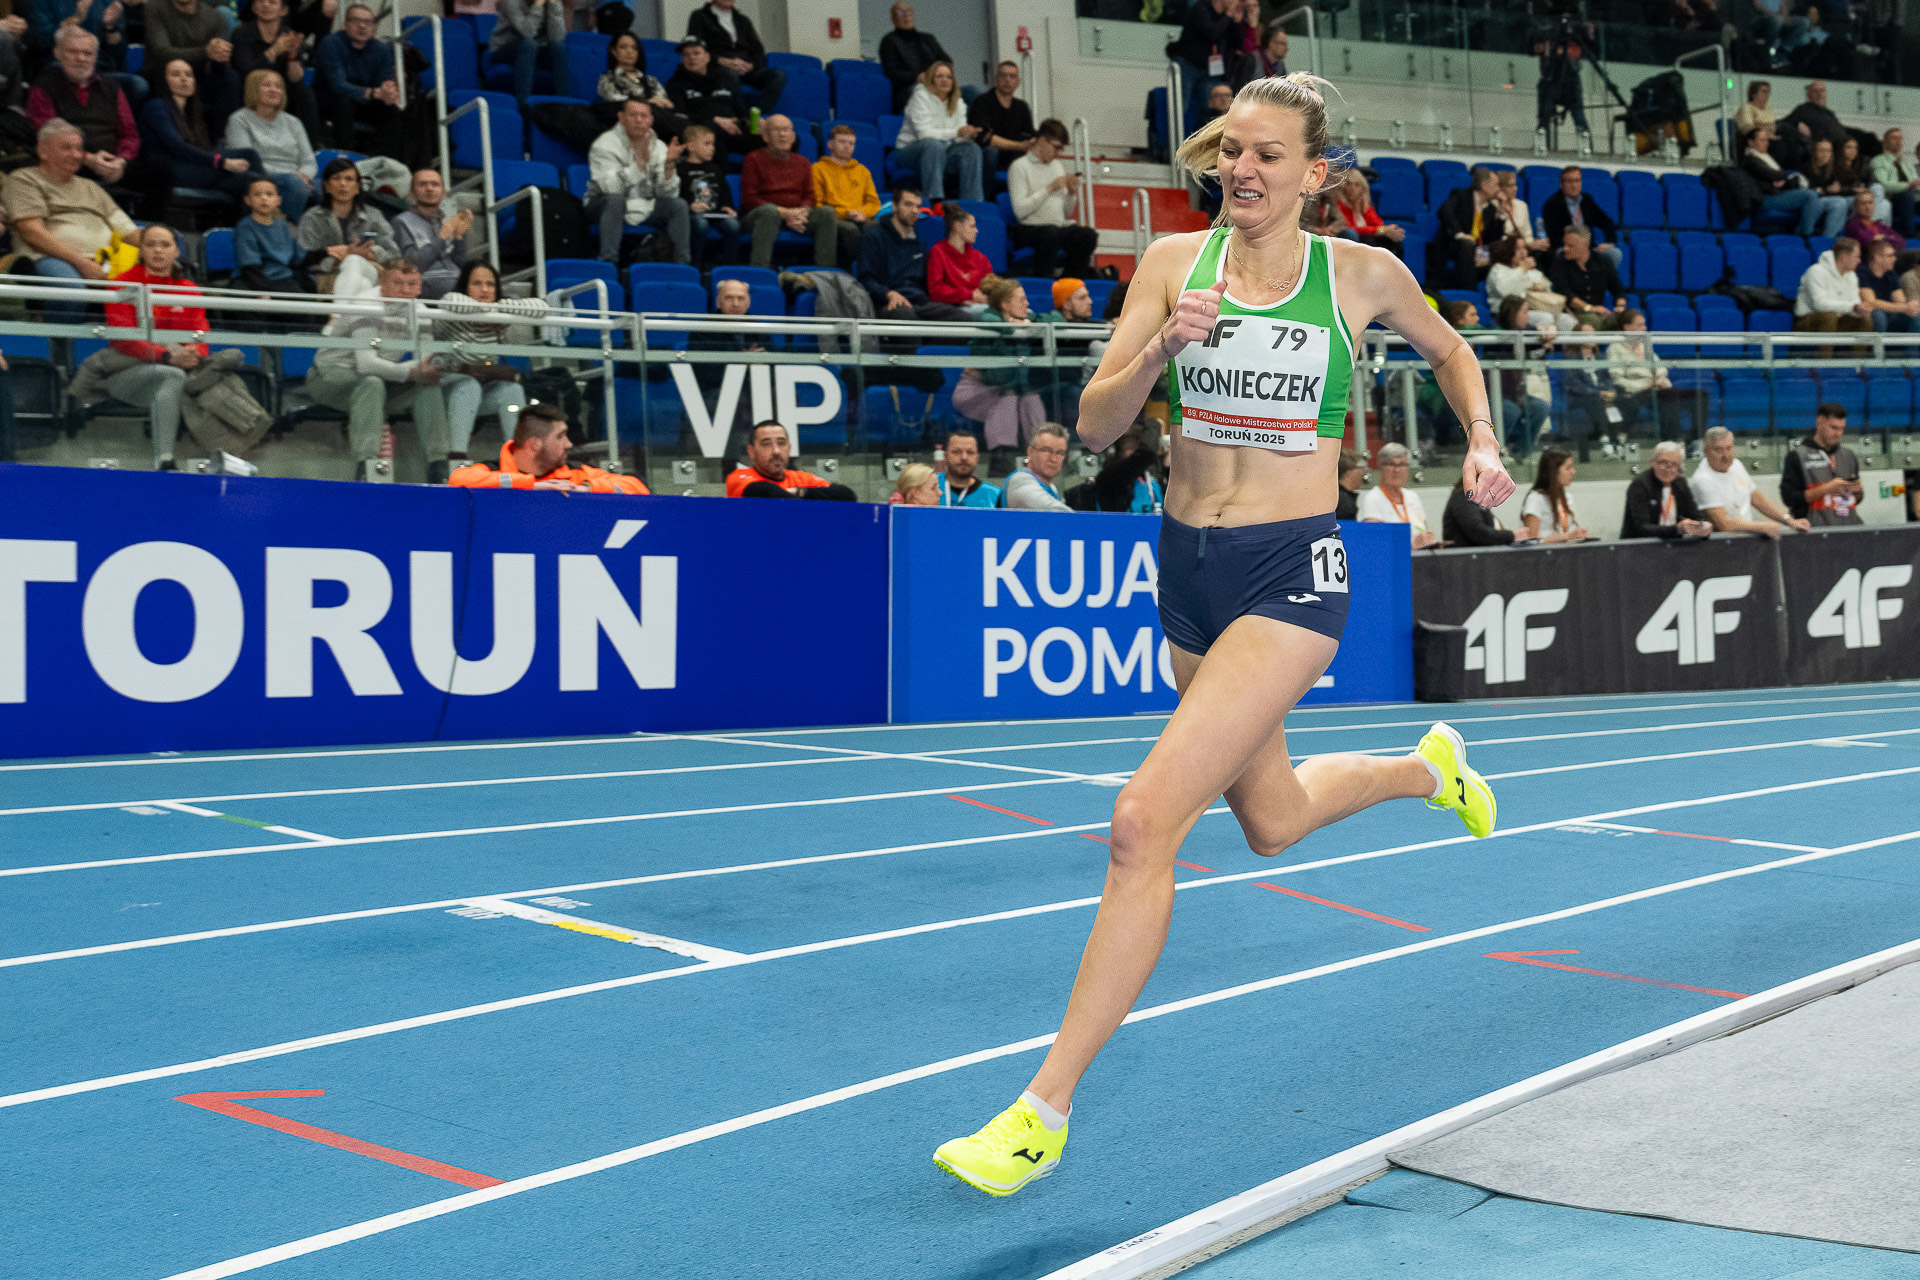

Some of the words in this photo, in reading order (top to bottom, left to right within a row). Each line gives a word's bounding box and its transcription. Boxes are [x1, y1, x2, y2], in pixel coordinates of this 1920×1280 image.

[1271, 325, 1308, 351] 79
[1181, 366, 1321, 402] KONIECZEK
[669, 363, 842, 458] VIP
[1187, 409, 1197, 417] 69.
[1199, 412, 1213, 421] PZLA
[1213, 415, 1242, 424] Halowe
[1243, 418, 1292, 429] Mistrzostwa
[1293, 421, 1313, 429] Polski
[1209, 428, 1251, 441] TORUŃ
[1254, 432, 1285, 444] 2025
[1313, 546, 1346, 583] 13
[1636, 575, 1752, 665] 4F
[1807, 564, 1913, 649] 4F
[1464, 588, 1569, 685] 4F
